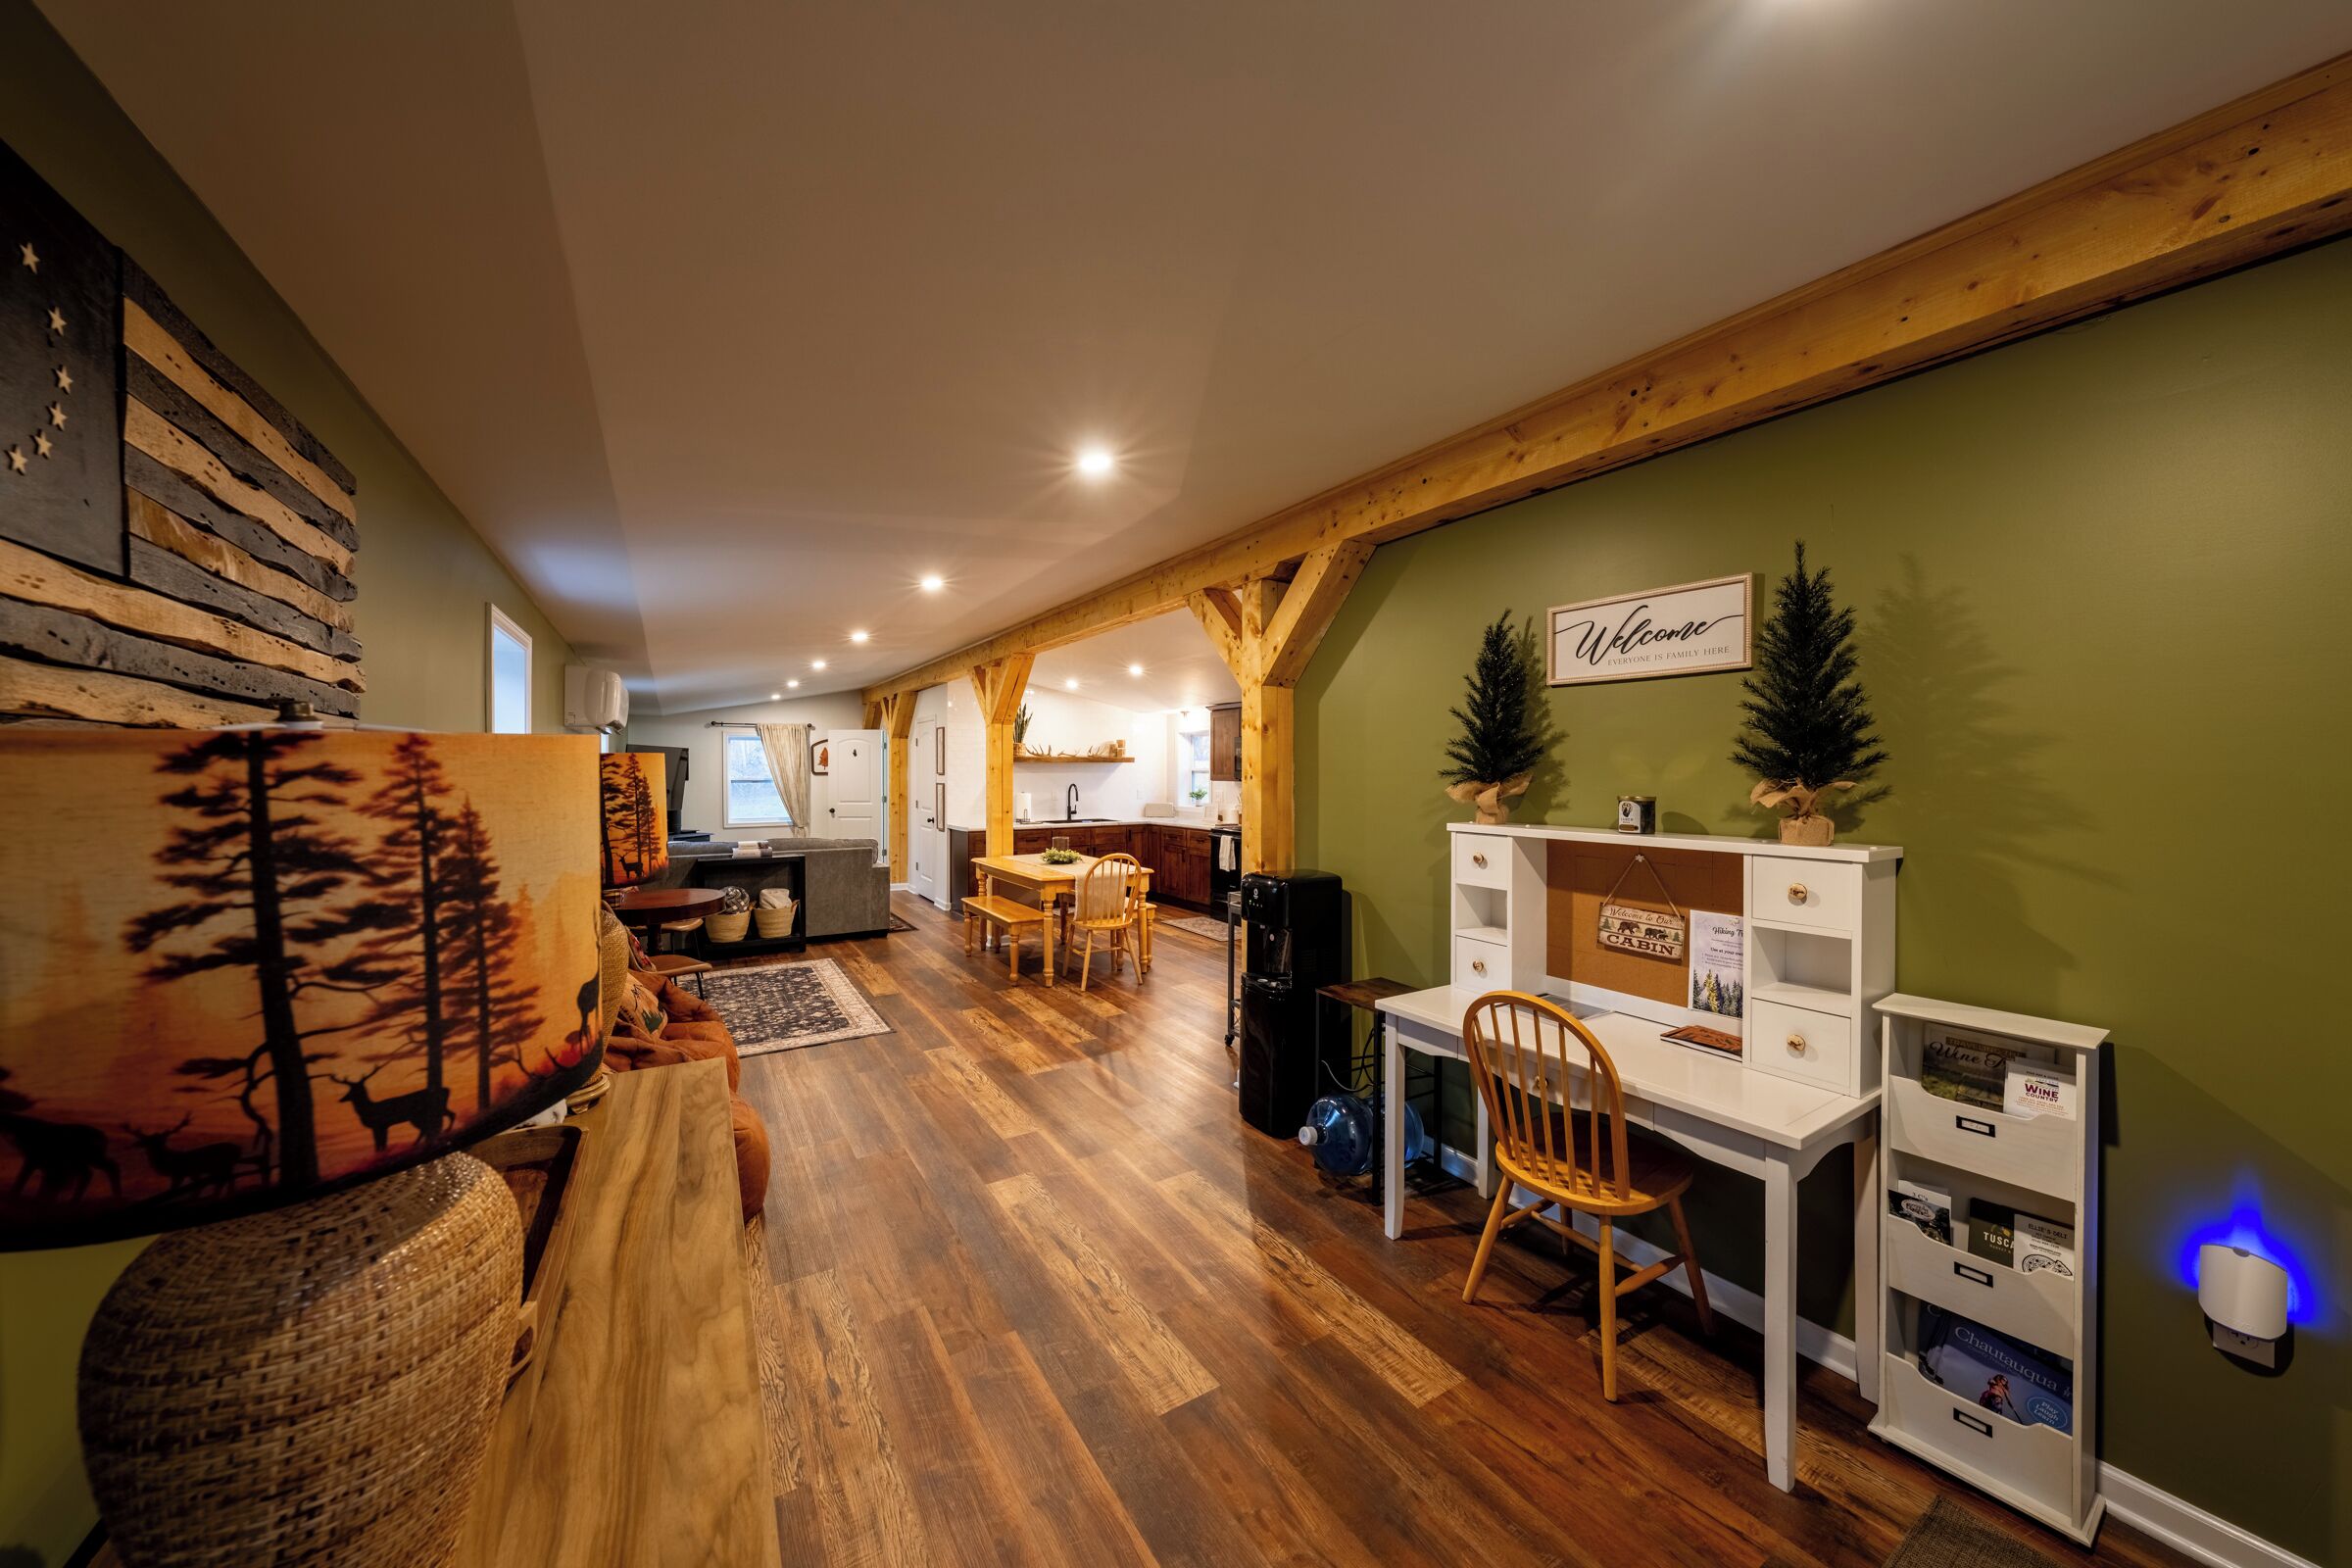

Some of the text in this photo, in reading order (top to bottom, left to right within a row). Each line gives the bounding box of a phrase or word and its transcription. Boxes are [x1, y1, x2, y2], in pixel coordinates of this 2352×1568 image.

[1555, 605, 1743, 665] Welcome
[1607, 655, 1651, 666] EVERYONE
[1666, 650, 1700, 660] FAMILY
[1703, 646, 1730, 656] HERE
[1609, 907, 1642, 919] Welcome
[1656, 915, 1674, 924] Our
[1712, 926, 1735, 937] Hiking
[1607, 934, 1675, 956] CABIN
[1929, 1041, 1982, 1064] Wine
[2025, 1083, 2059, 1099] WINE
[2026, 1092, 2058, 1102] COUNTRY
[1955, 1327, 2058, 1392] Chautauqua
[2035, 1403, 2059, 1421] Laugh
[2041, 1401, 2058, 1414] Play
[2034, 1409, 2055, 1425] Learn
